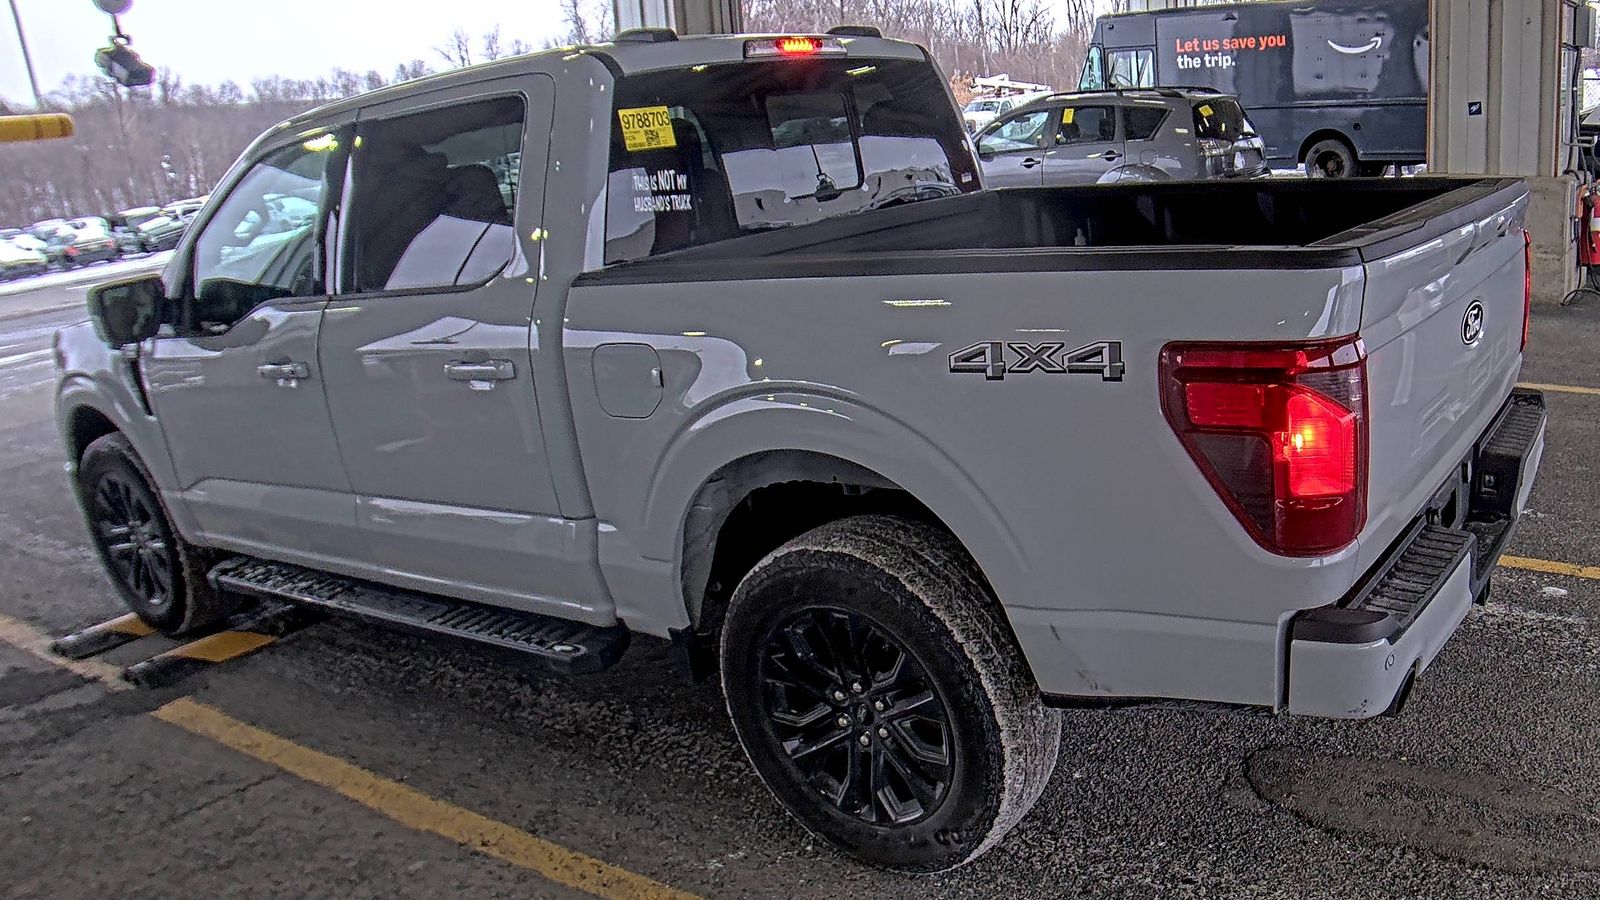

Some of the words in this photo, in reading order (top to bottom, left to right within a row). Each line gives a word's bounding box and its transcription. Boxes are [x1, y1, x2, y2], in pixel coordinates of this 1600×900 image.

[1176, 38, 1200, 53] Let
[1203, 40, 1220, 51] us
[1222, 37, 1256, 50] save
[1259, 35, 1286, 51] you
[1176, 55, 1201, 69] the
[1204, 52, 1236, 69] trip.
[621, 111, 670, 130] 9788703
[633, 175, 650, 191] THIS
[650, 175, 658, 191] IS
[657, 170, 676, 191] NOT
[676, 174, 688, 190] MY
[634, 195, 671, 212] HUSBAND'S
[671, 195, 692, 210] TRUCK
[949, 341, 1125, 382] 4X4
